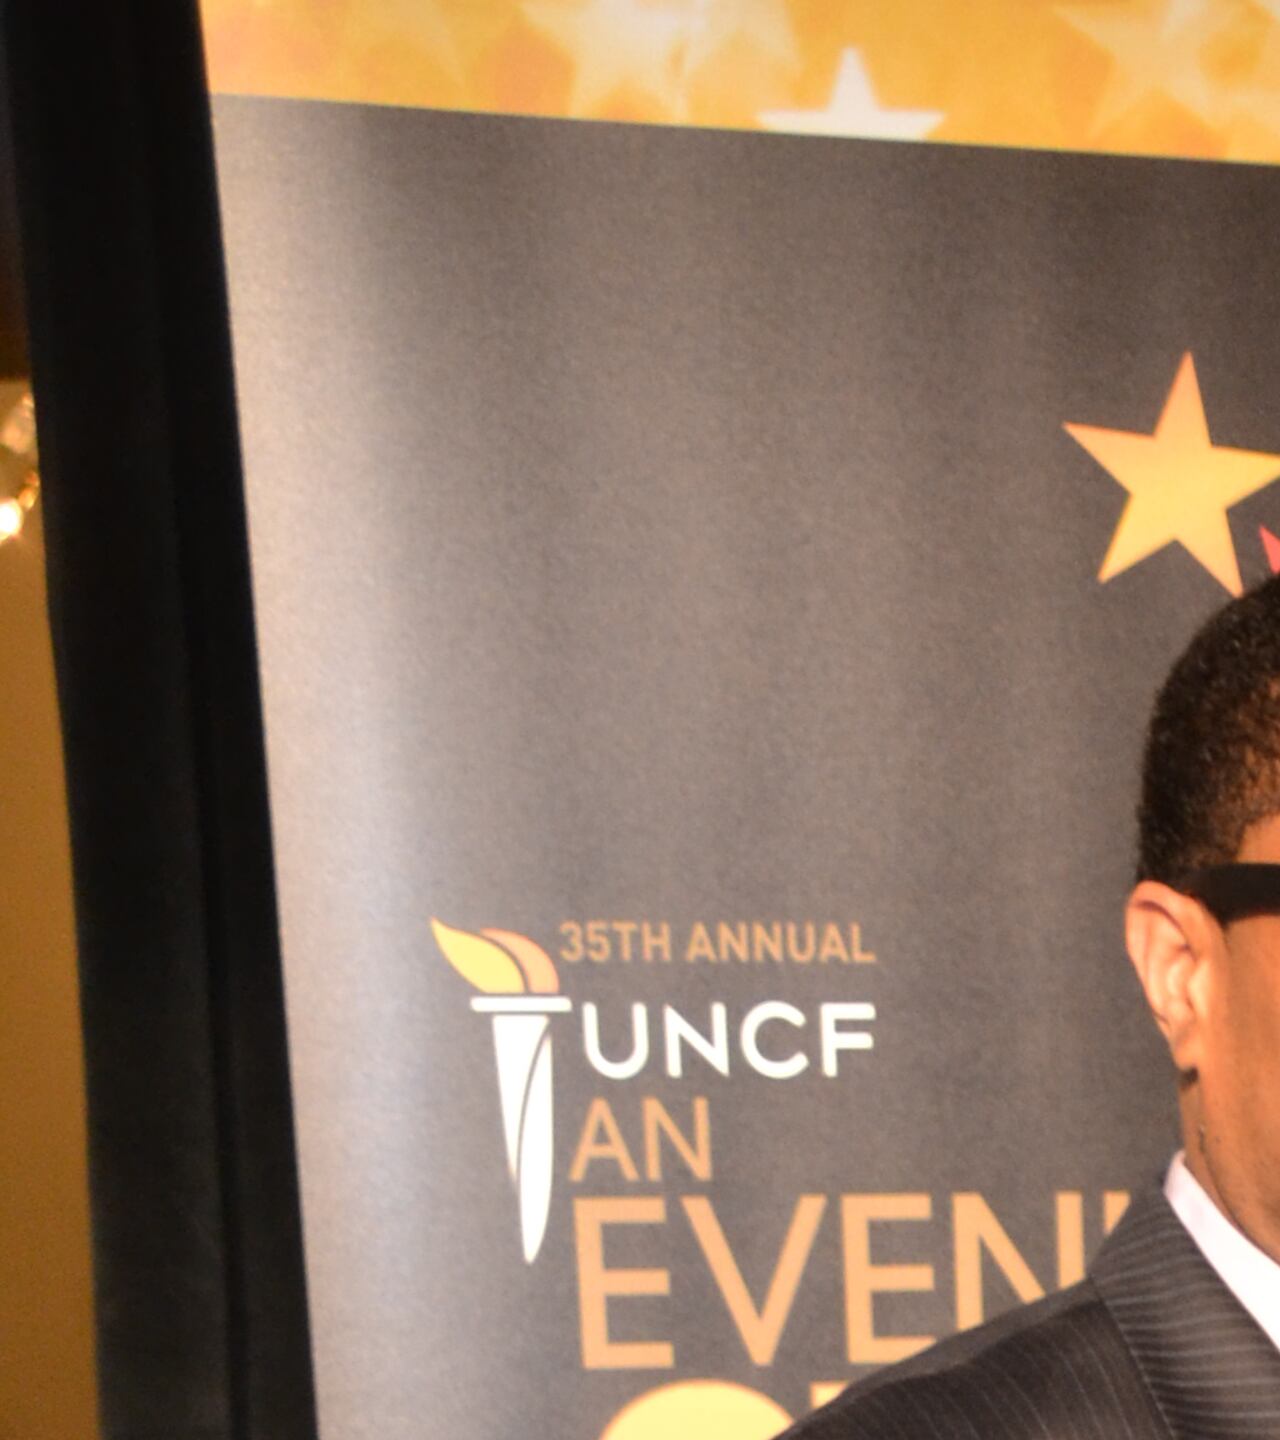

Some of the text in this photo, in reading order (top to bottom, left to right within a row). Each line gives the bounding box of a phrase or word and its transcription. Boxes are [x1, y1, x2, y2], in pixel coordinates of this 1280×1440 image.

[558, 920, 877, 963] 35TH ANNUAL
[582, 1001, 877, 1079] UNCF
[569, 1096, 713, 1182] AN
[573, 1191, 1131, 1369] EVEN
